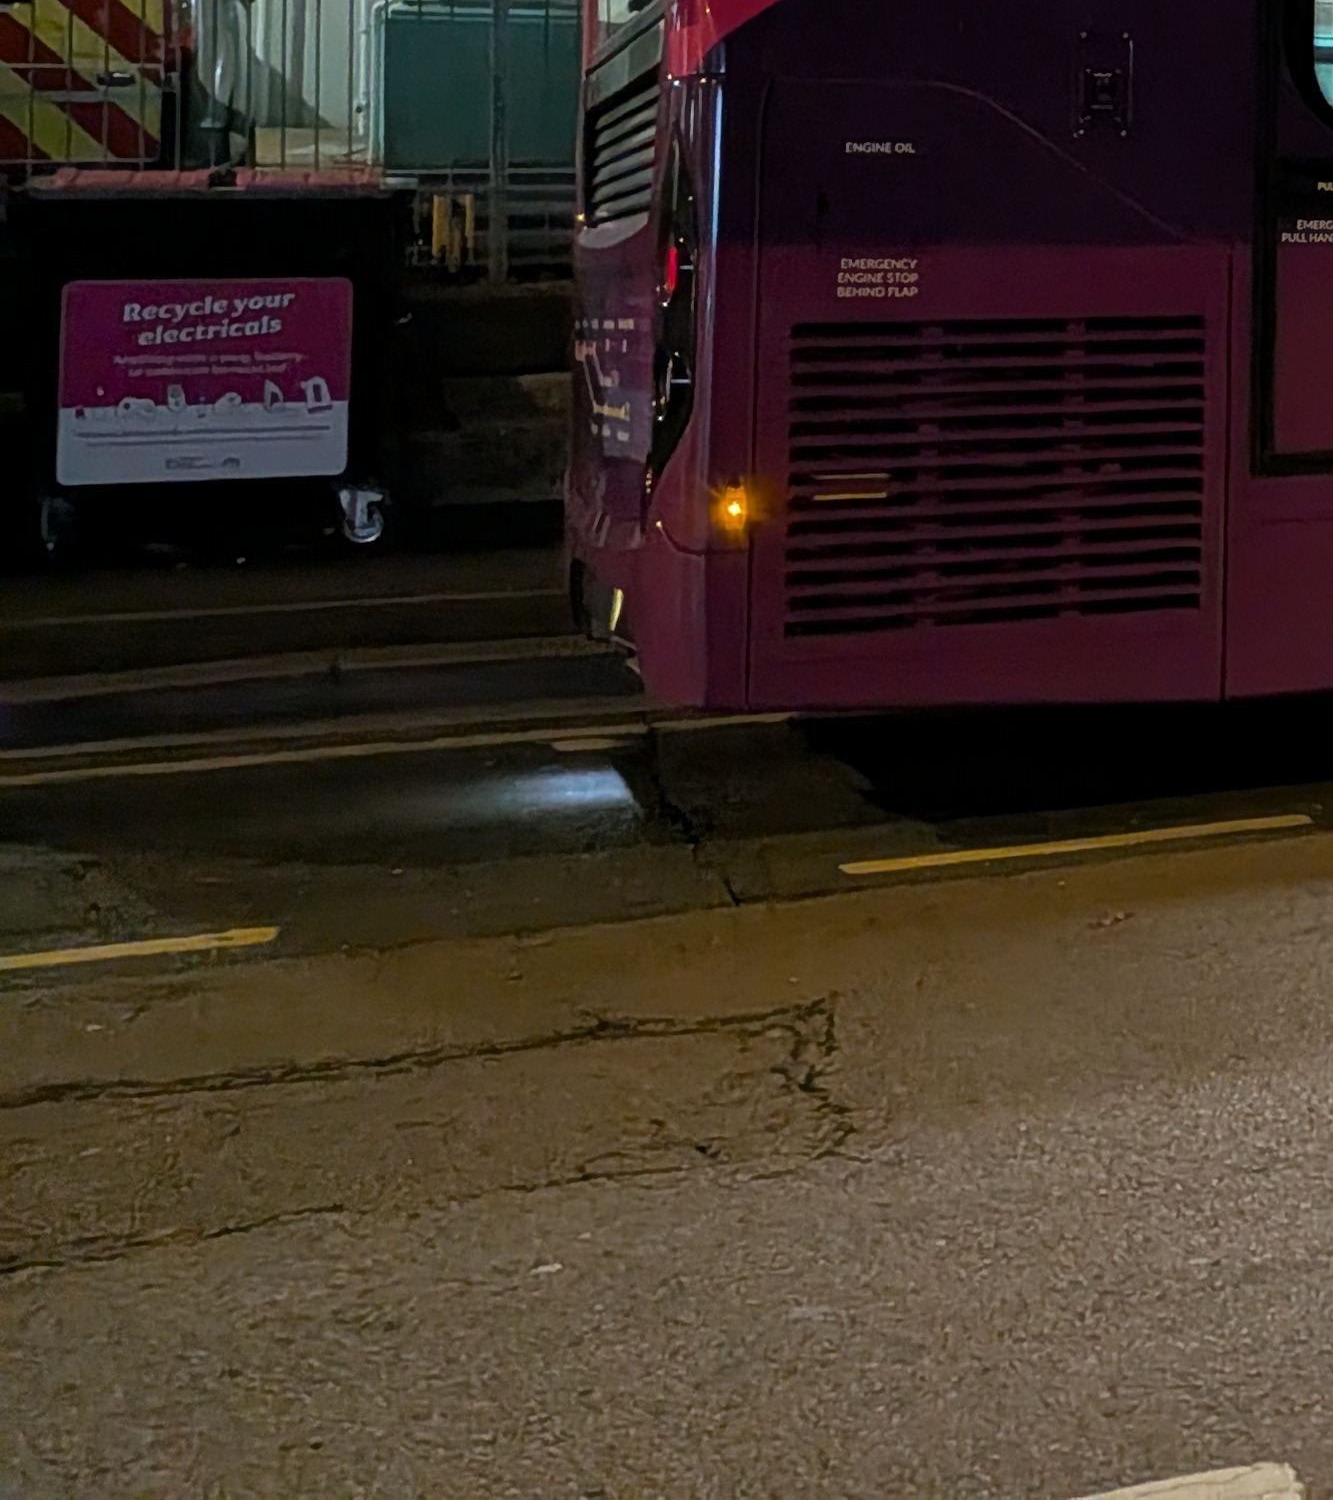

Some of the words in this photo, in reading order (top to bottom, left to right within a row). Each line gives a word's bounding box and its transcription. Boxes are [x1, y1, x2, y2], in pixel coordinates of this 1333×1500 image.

[845, 141, 892, 154] ENGINE
[894, 142, 916, 154] OIL
[1281, 232, 1308, 242] PULL
[840, 257, 918, 270] EMERGENCY
[837, 271, 885, 284] ENGINE
[886, 271, 919, 284] STOP
[836, 285, 885, 298] BEHIND
[887, 285, 919, 298] FLAP
[123, 296, 229, 323] Recycle
[230, 293, 296, 318] your
[138, 316, 283, 346] electricals
